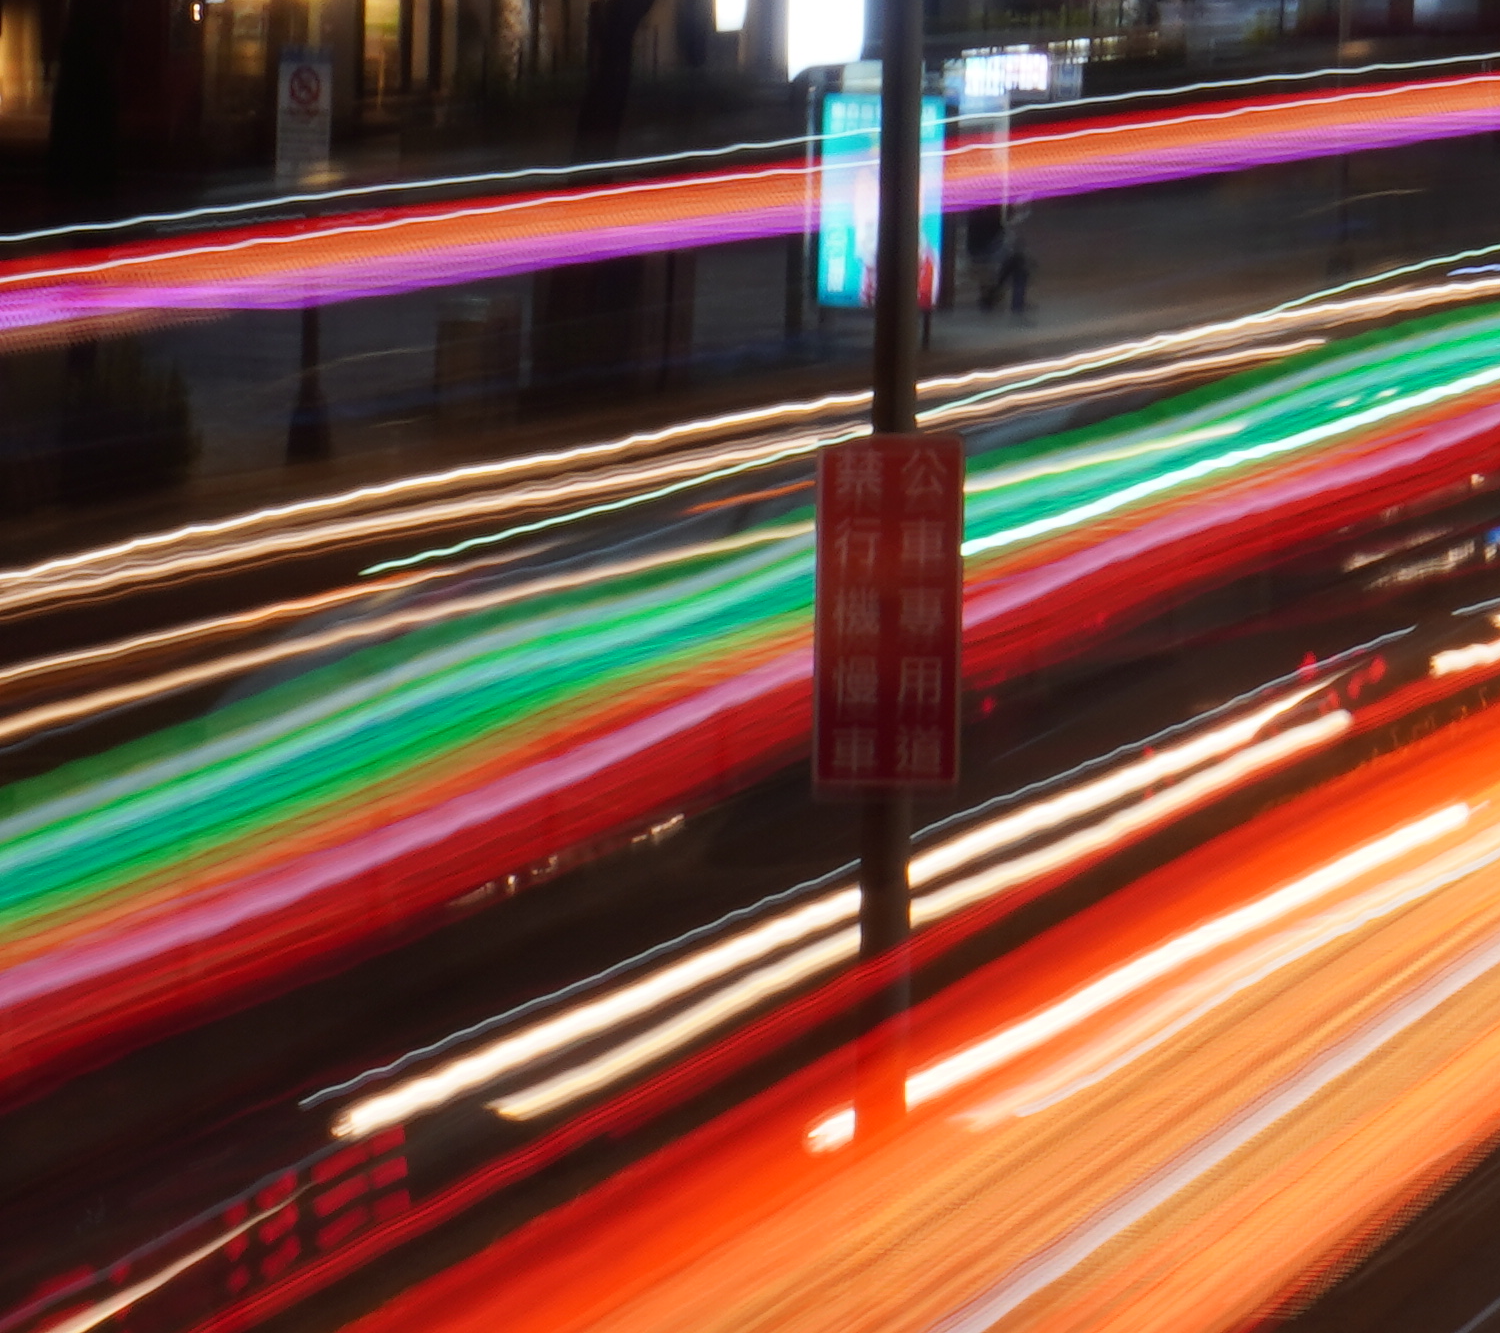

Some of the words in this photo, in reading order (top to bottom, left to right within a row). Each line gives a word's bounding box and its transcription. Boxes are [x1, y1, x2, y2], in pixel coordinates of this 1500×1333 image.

[833, 449, 882, 773] 禁行機慢車
[898, 447, 946, 774] 公車專用道
